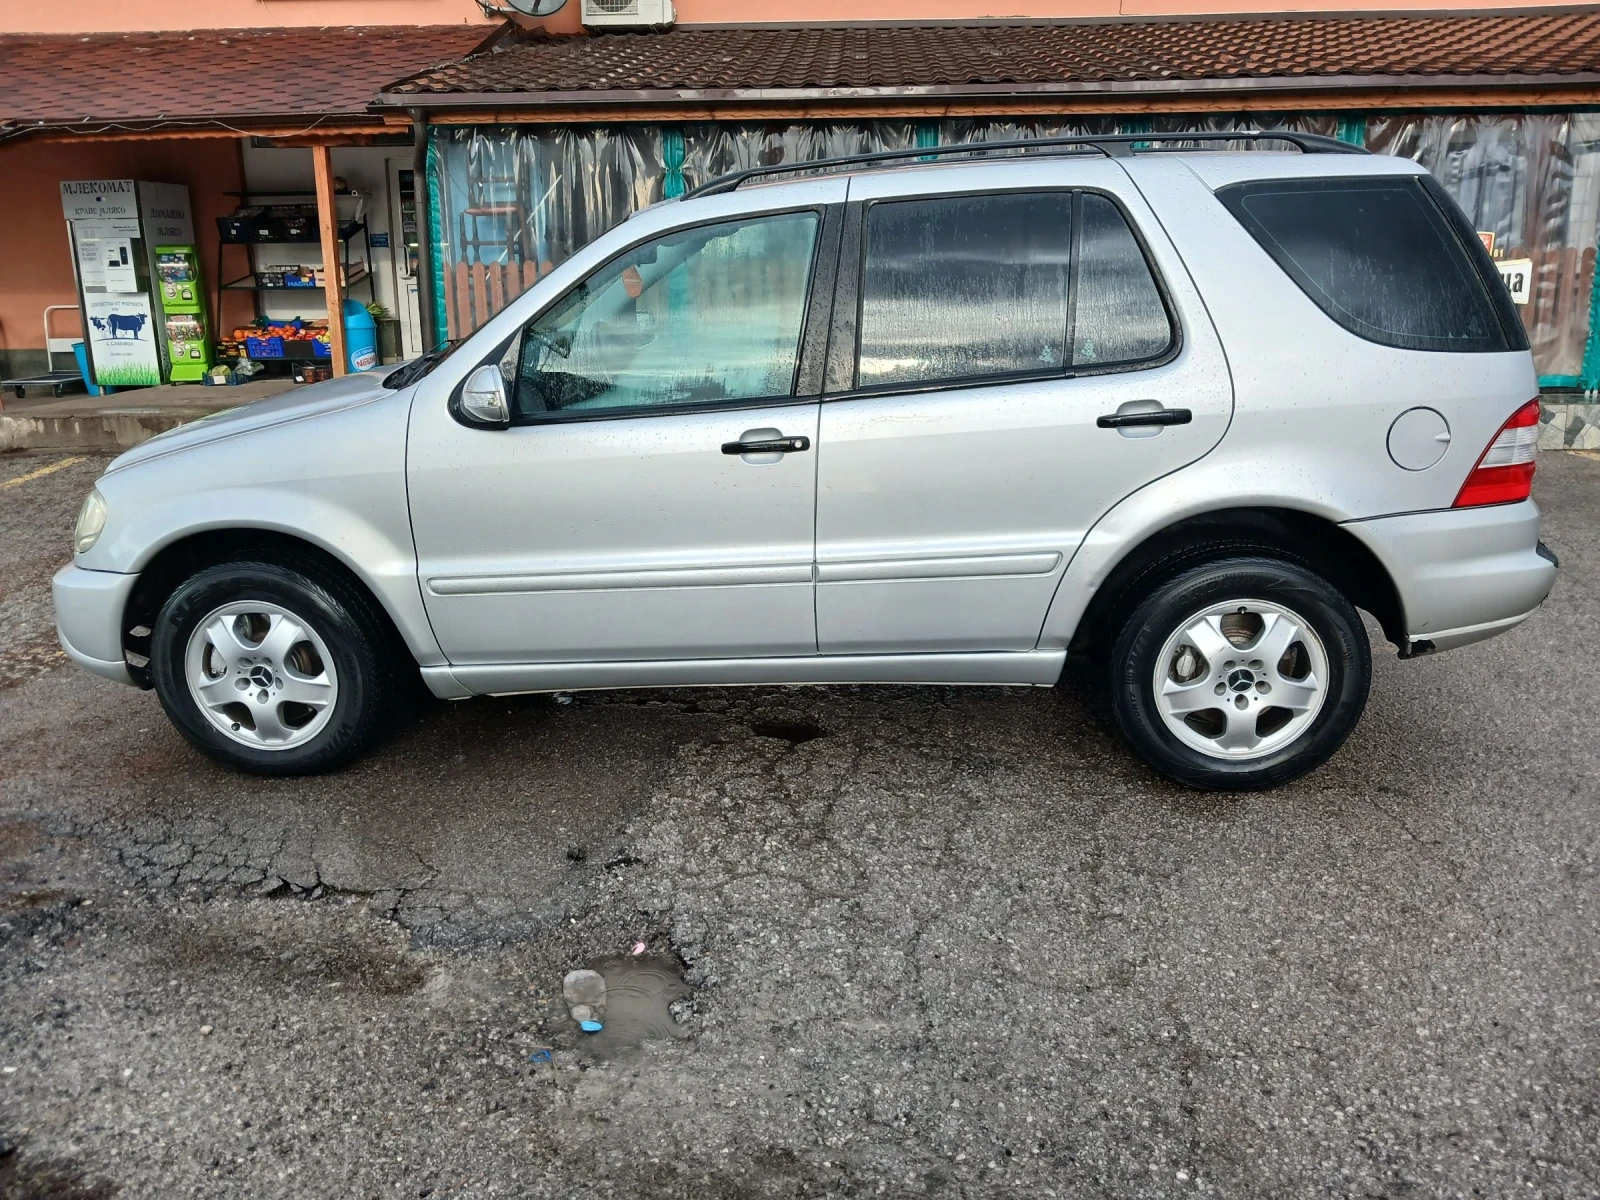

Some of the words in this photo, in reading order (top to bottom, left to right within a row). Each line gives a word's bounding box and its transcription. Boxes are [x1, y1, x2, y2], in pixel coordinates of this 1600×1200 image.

[63, 181, 132, 195] МЛЕКОМАТ
[74, 207, 98, 215] КРАВЕ
[99, 206, 126, 216] МЛЯКО
